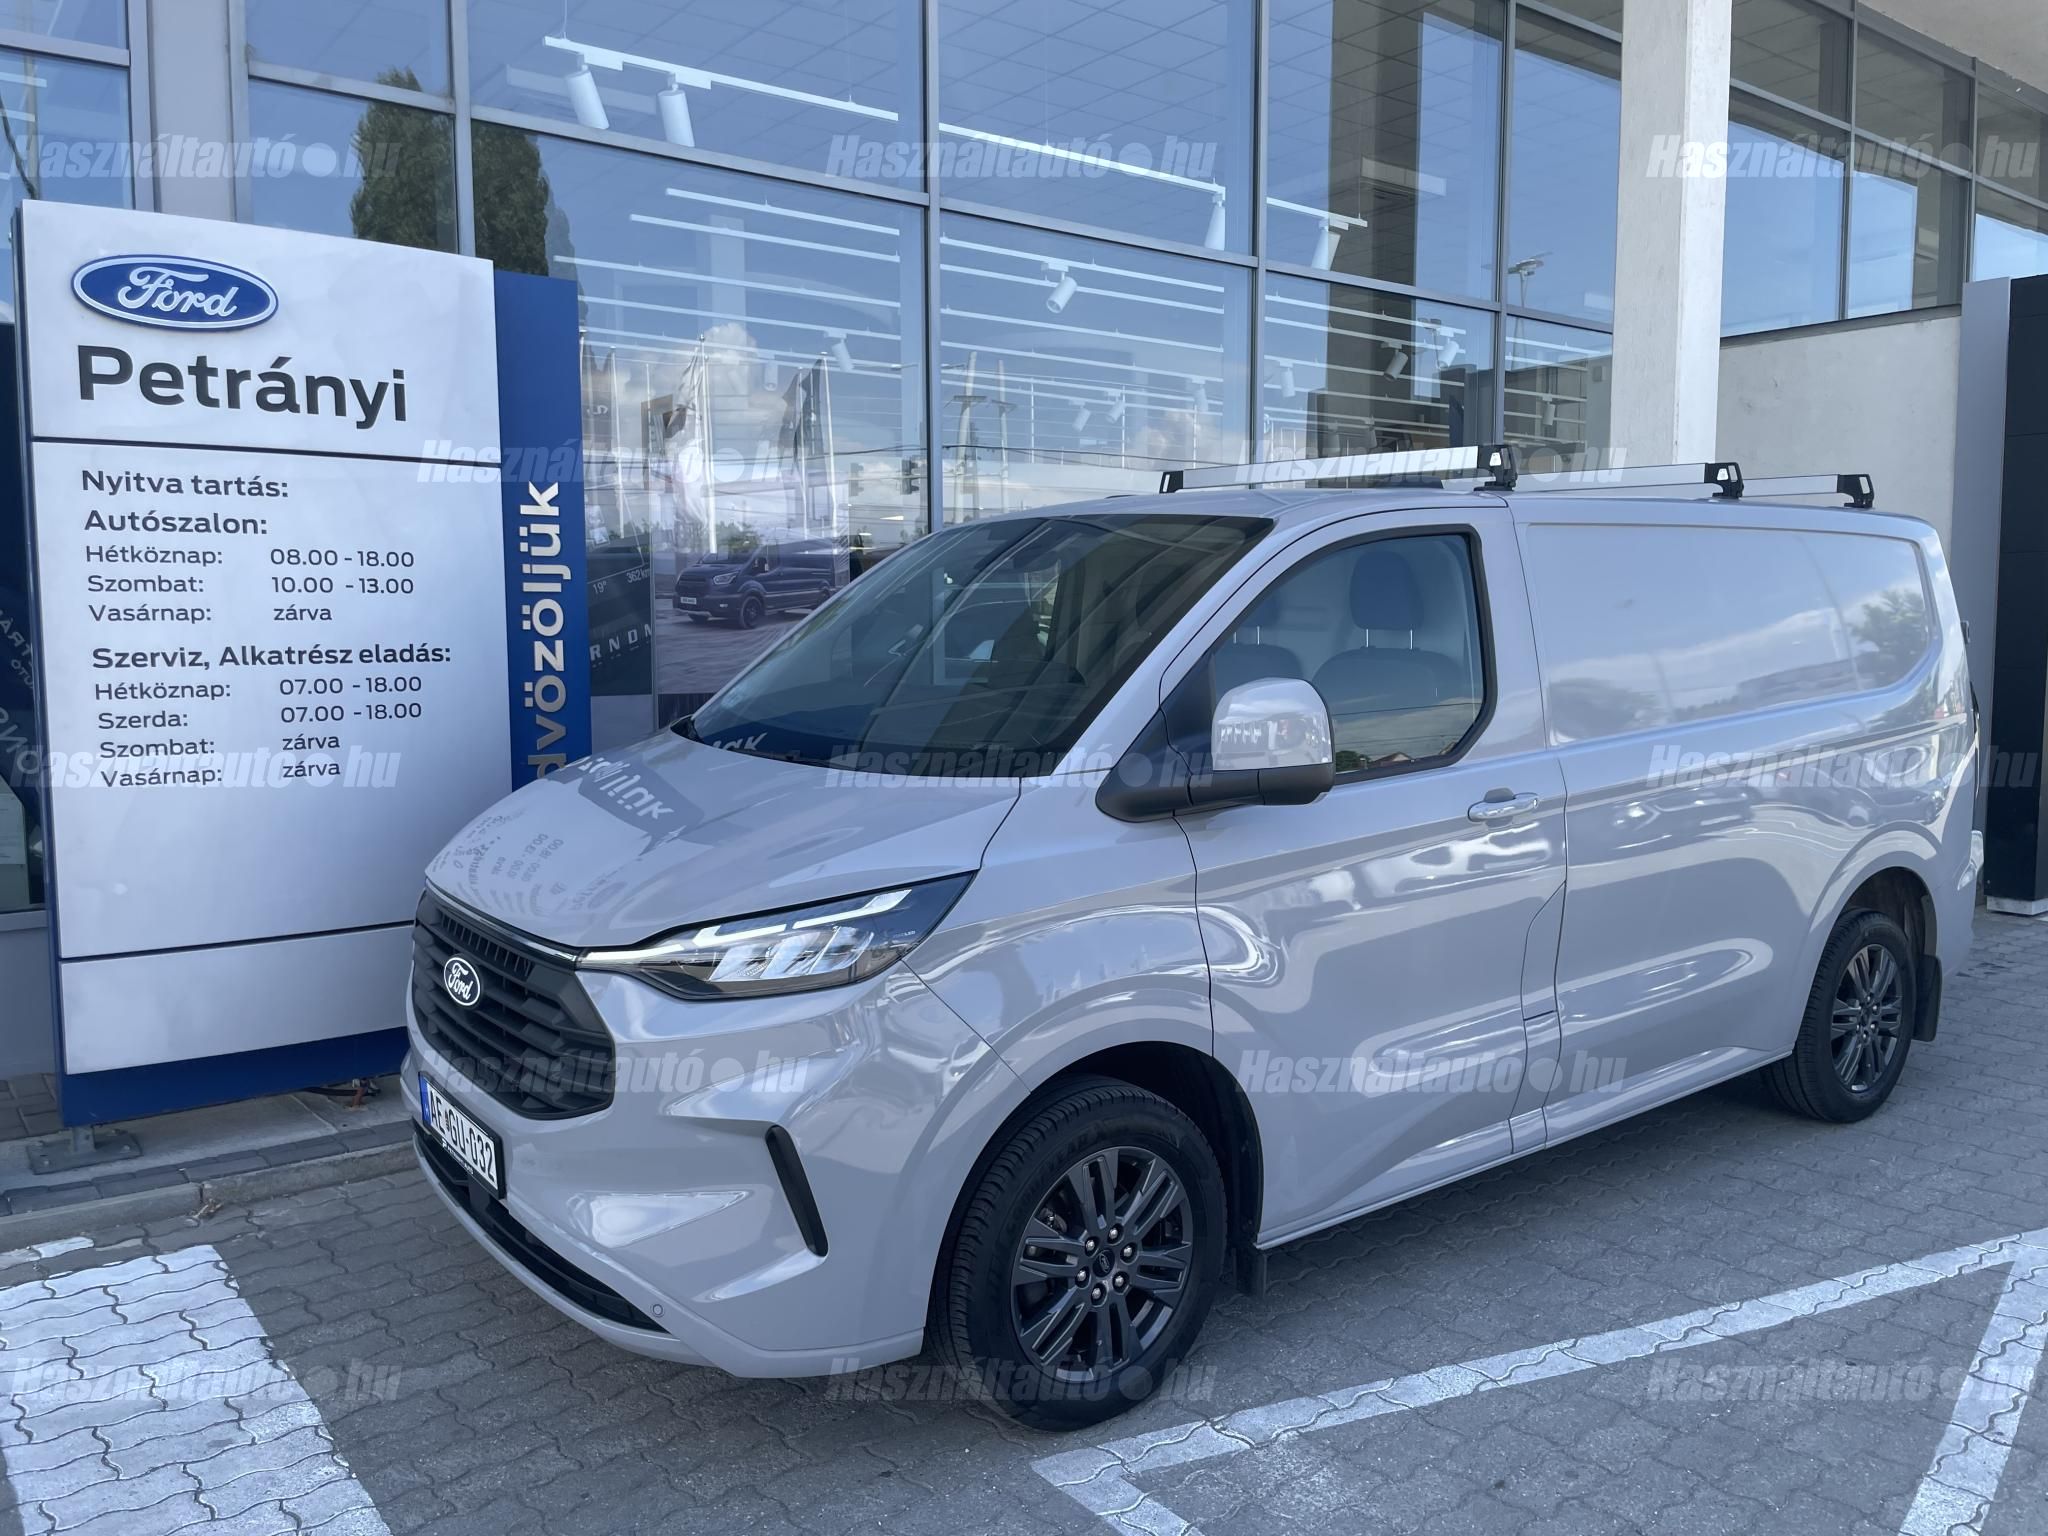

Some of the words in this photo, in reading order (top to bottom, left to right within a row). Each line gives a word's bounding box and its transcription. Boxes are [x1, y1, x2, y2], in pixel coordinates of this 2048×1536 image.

[116, 265, 239, 318] Ford
[78, 345, 407, 429] Petrányi
[81, 470, 184, 498] Nyitva
[191, 475, 289, 498] tartás:
[84, 509, 267, 535] Autószalon:
[85, 545, 223, 568] Hétköznap:
[270, 548, 338, 566] 08.00
[87, 575, 204, 593] Szombat:
[271, 576, 334, 593] 10.00
[88, 604, 212, 625] Vasárnap:
[273, 604, 333, 621] zárva
[519, 480, 572, 779] dvözöljük
[92, 646, 211, 671] Szerviz,
[218, 643, 354, 667] Alkatrész
[358, 642, 451, 665] eladás:
[95, 681, 232, 701] Hétköznap:
[279, 678, 344, 696] 07.00
[98, 710, 188, 730] Szerda:
[280, 705, 345, 724] 07.00
[99, 739, 215, 759] Szombat:
[282, 733, 341, 751] zárva
[101, 767, 223, 788] Vasárnap:
[282, 760, 341, 778] zárva
[430, 1091, 446, 1134] AE
